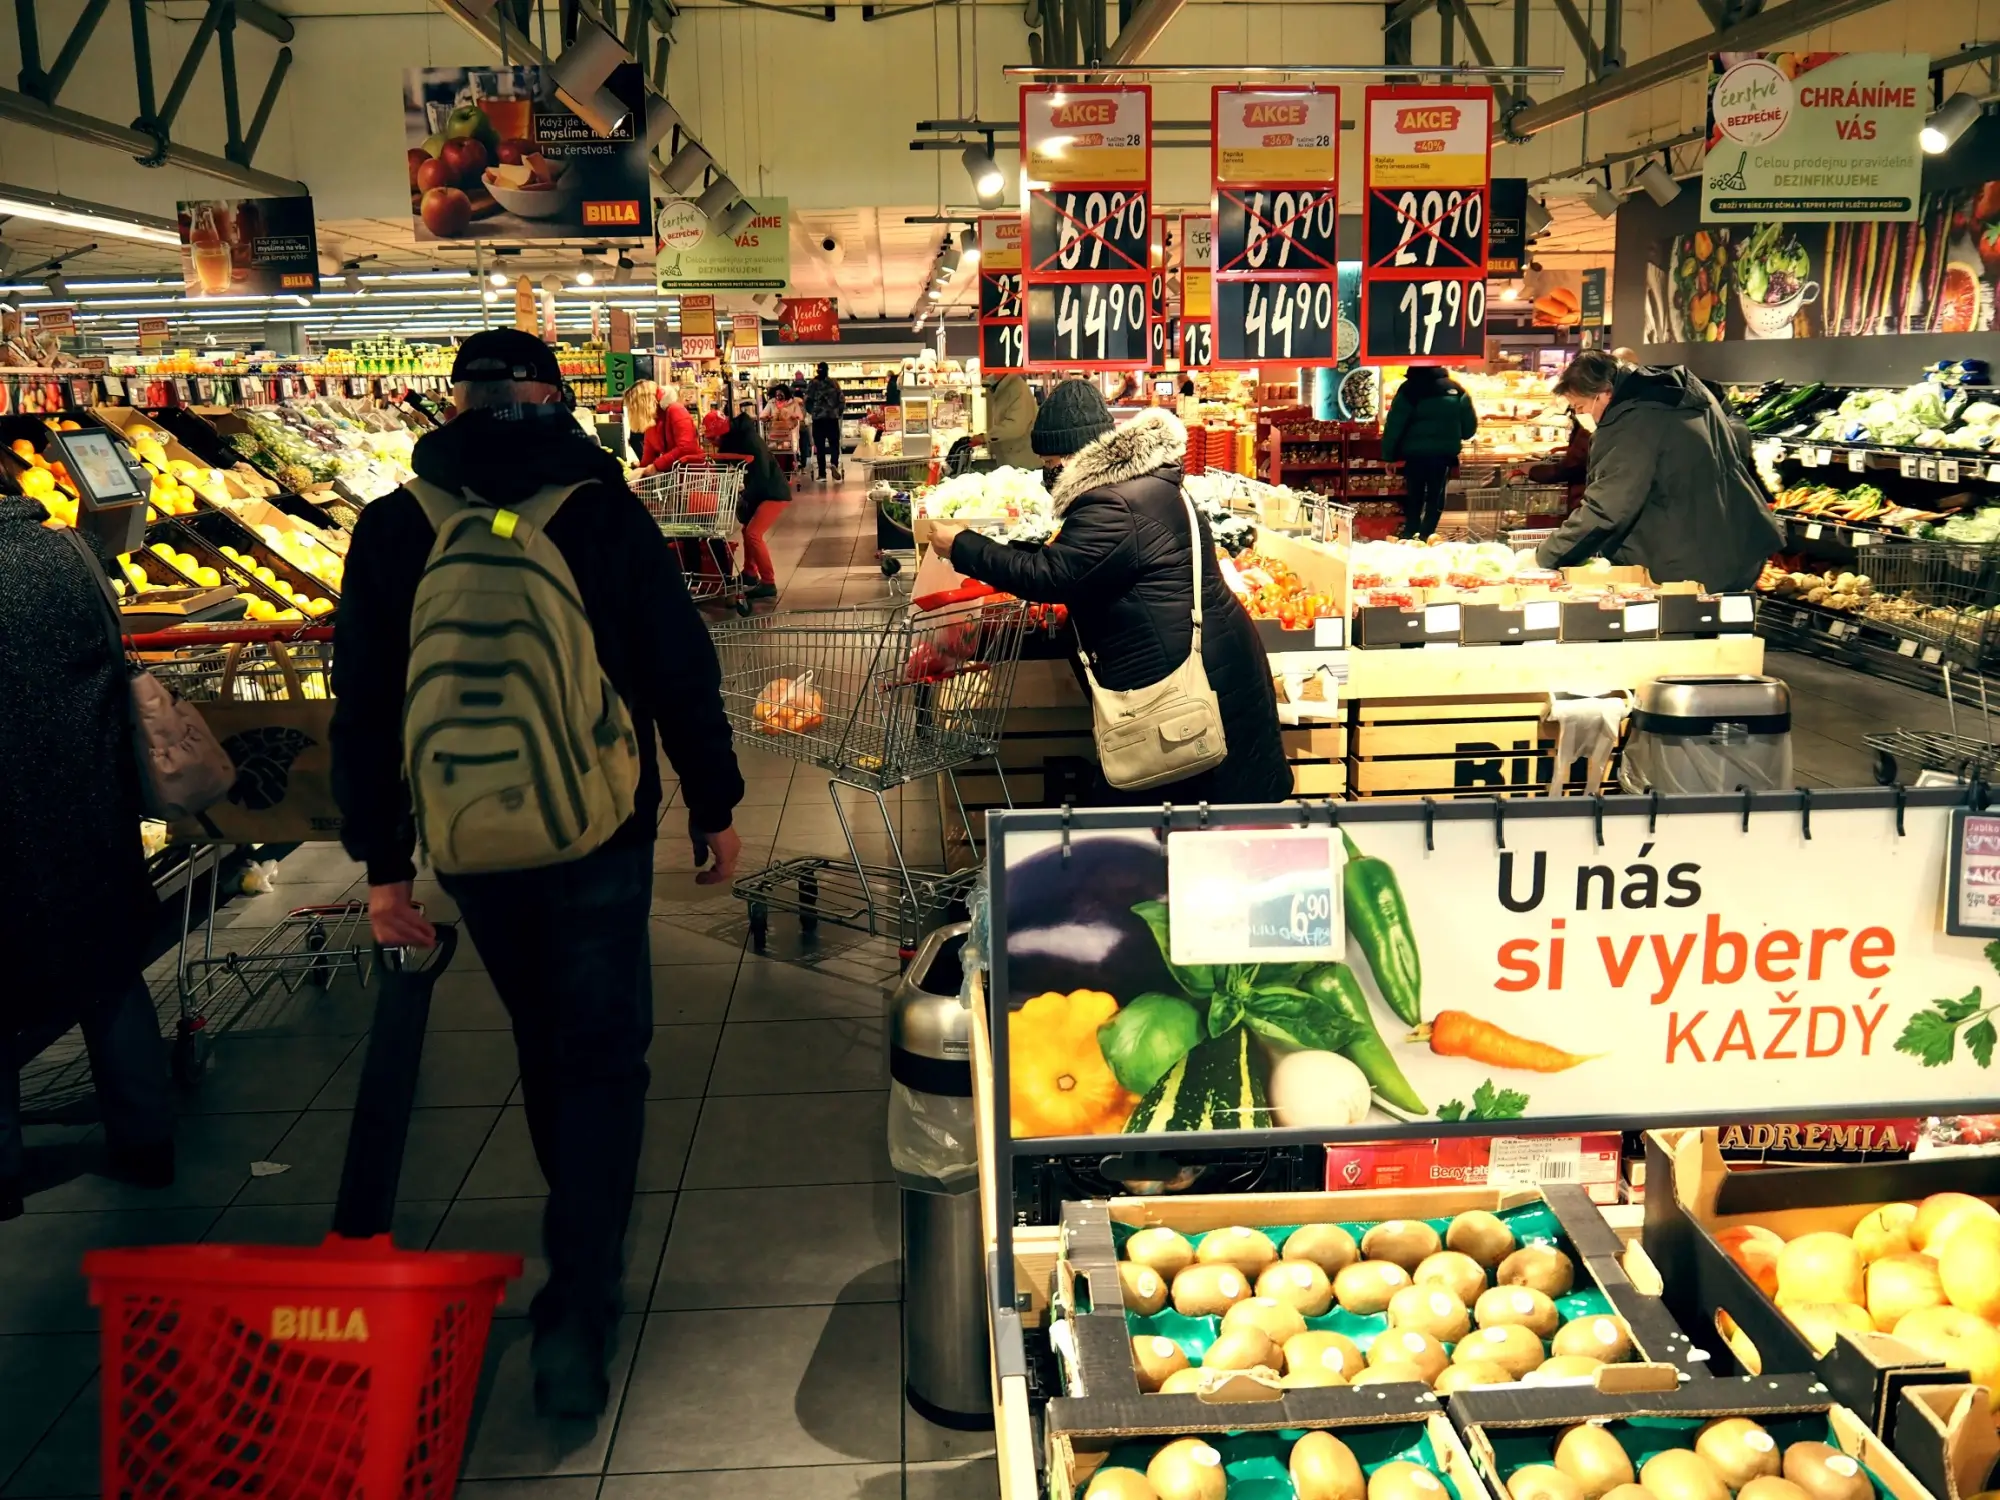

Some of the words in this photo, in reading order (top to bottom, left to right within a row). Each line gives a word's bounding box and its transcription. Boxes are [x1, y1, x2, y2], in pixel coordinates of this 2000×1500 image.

[1721, 76, 1777, 108] čerstvé
[1800, 81, 1916, 108] CHRÁNÍME
[540, 117, 563, 128] Když
[564, 117, 579, 128] jde
[1059, 105, 1110, 123] AKCE
[1250, 105, 1301, 123] AKCE
[1402, 111, 1453, 129] AKCE
[1727, 107, 1782, 127] BEZPEČNÉ
[540, 127, 589, 141] myslíme
[1835, 113, 1877, 140] VÁS
[1126, 134, 1141, 146] 28
[1316, 135, 1330, 147] 28
[1416, 140, 1443, 151] -40%
[547, 146, 562, 156] na
[564, 144, 617, 155] čerstvost.
[1754, 156, 1790, 169] Celou
[1793, 156, 1848, 172] prodejnu
[1850, 155, 1914, 171] pravidelně
[1773, 174, 1879, 187] DEZINFIKUJEME
[586, 204, 637, 222] BILLA
[283, 275, 313, 287] BILLA
[684, 297, 710, 306] AKCE
[310, 817, 345, 826] TESC
[1498, 850, 1547, 913] U
[1575, 842, 1702, 911] nás
[1494, 918, 1566, 992] si
[1596, 913, 1896, 1005] vybere
[1665, 987, 1890, 1064] KAŽDÝ
[1719, 1123, 1900, 1153] ADREMIA
[271, 1305, 369, 1343] BILLA
